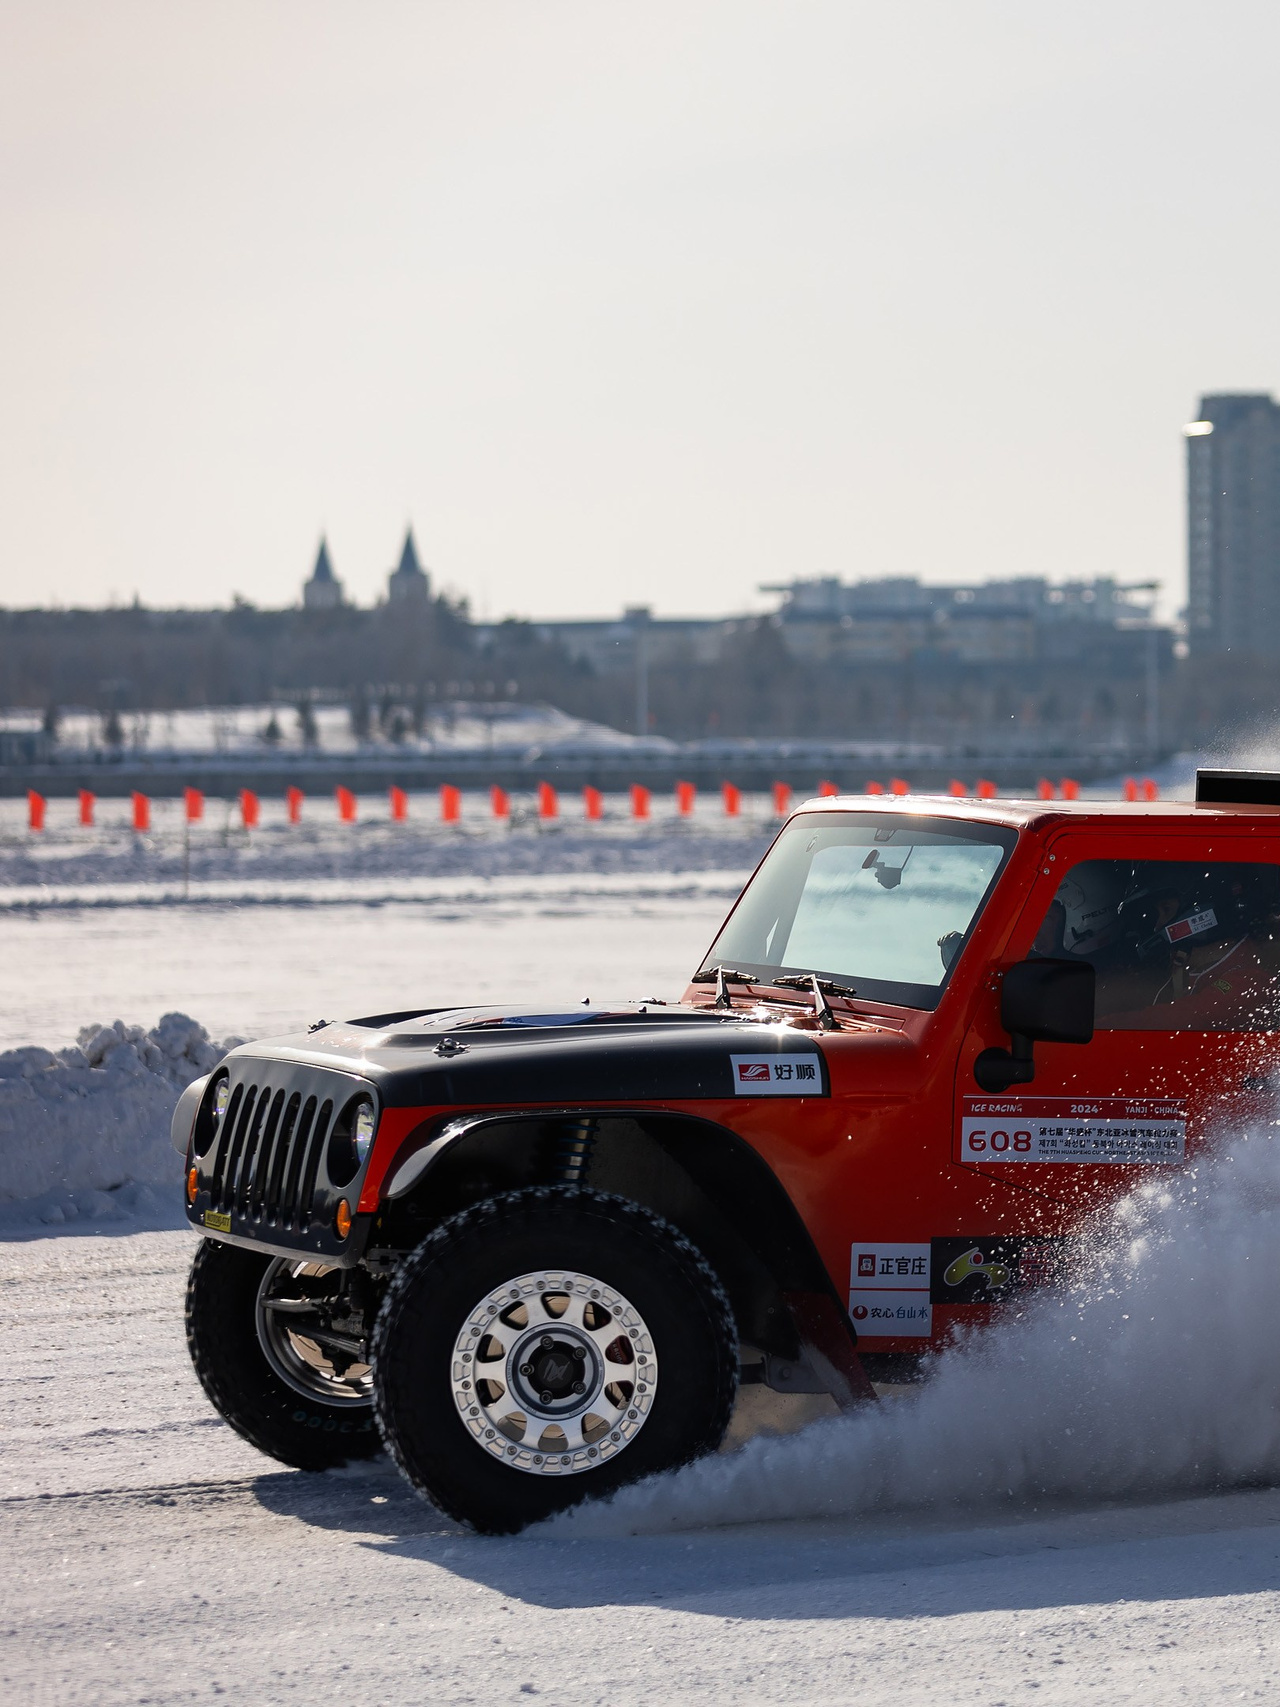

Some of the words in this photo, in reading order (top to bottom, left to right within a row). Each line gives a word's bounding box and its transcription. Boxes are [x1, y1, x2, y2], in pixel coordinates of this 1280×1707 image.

[1081, 904, 1113, 921] PELT
[774, 1064, 816, 1080] 好顺
[971, 1103, 987, 1113] ICE
[988, 1103, 1023, 1113] RACING
[1070, 1104, 1099, 1114] 2024
[1125, 1106, 1148, 1114] YANJI
[1154, 1106, 1179, 1115] CHINA
[968, 1130, 1032, 1152] 608
[879, 1256, 927, 1275] 正官庄
